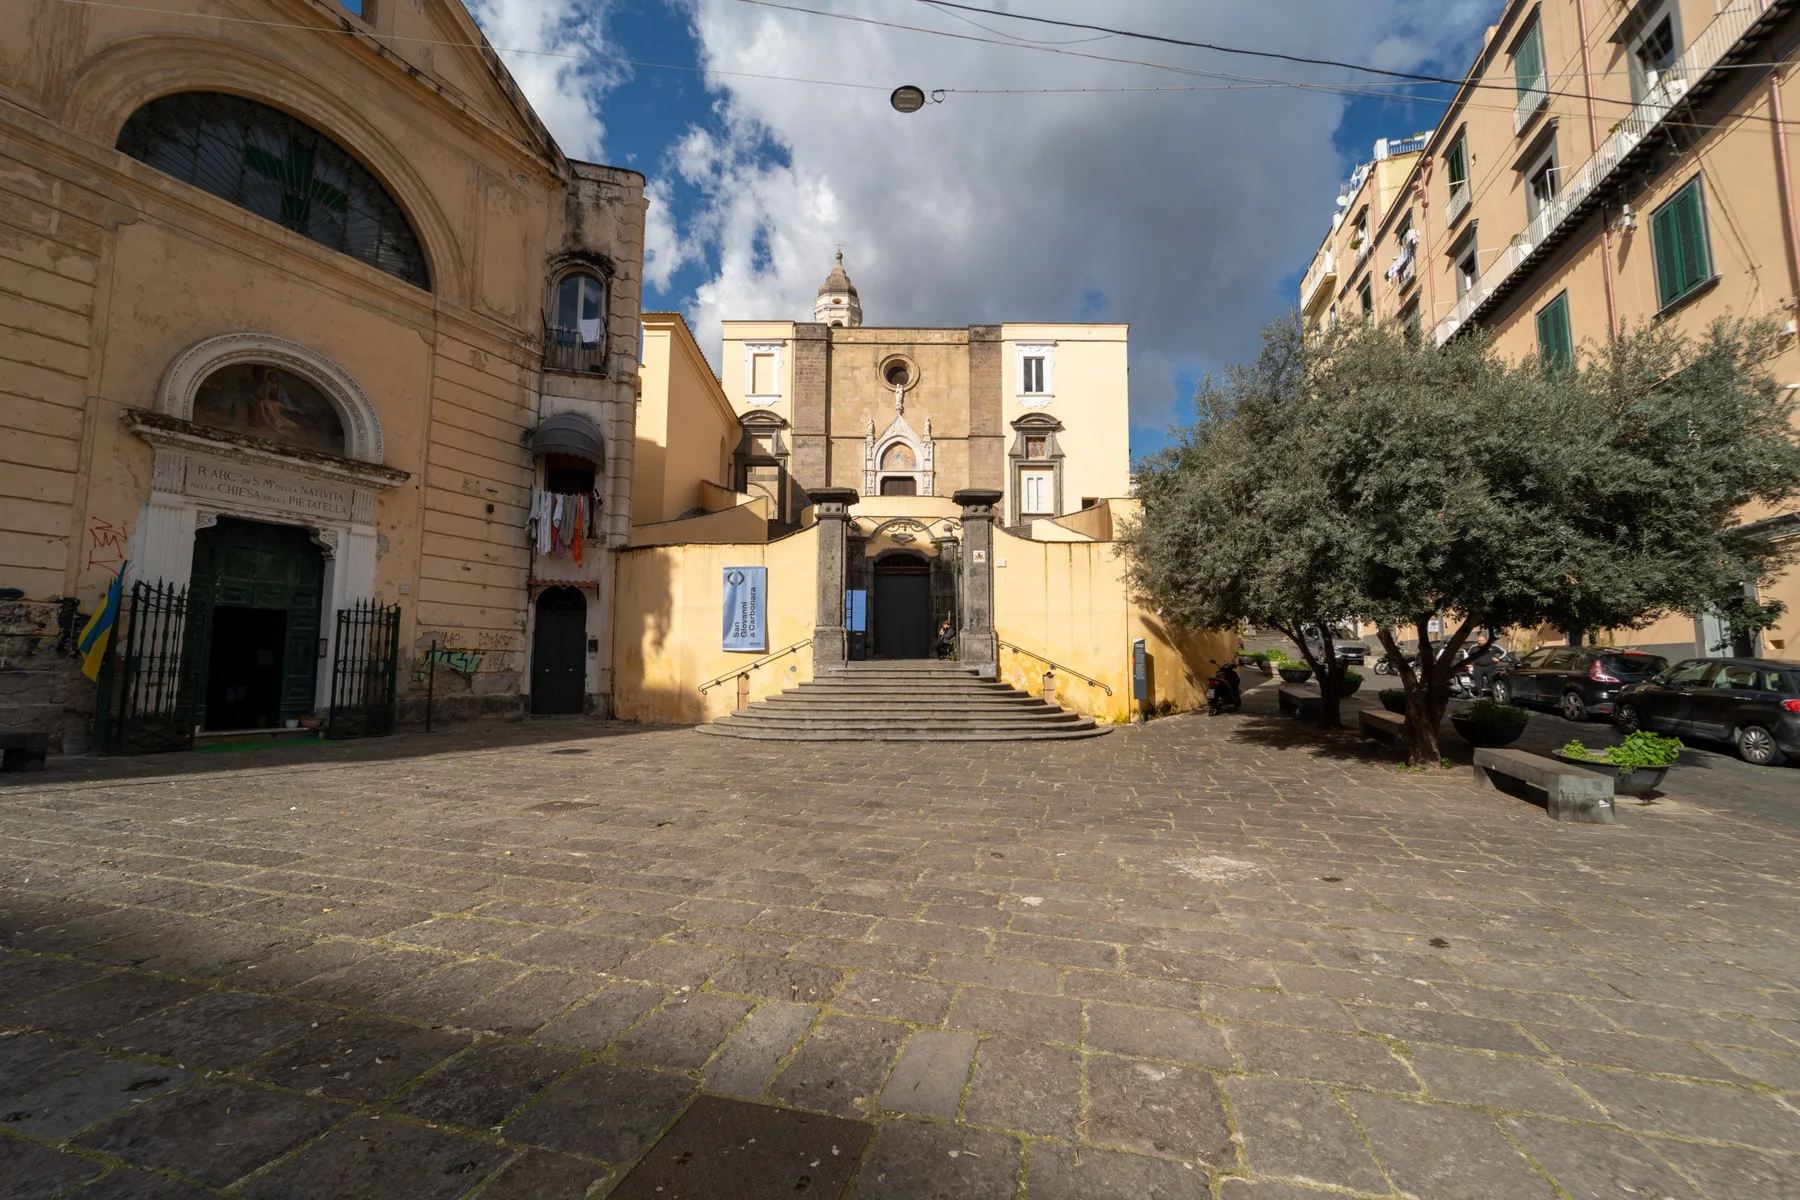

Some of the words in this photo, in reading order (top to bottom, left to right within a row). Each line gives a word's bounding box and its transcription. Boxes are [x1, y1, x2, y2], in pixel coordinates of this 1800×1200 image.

[191, 482, 215, 492] NELLA
[217, 483, 260, 499] CHIESA
[264, 495, 286, 504] DELLA
[289, 496, 347, 515] PIETATELLA
[276, 484, 297, 493] DELLA
[748, 587, 756, 631] Carbonara
